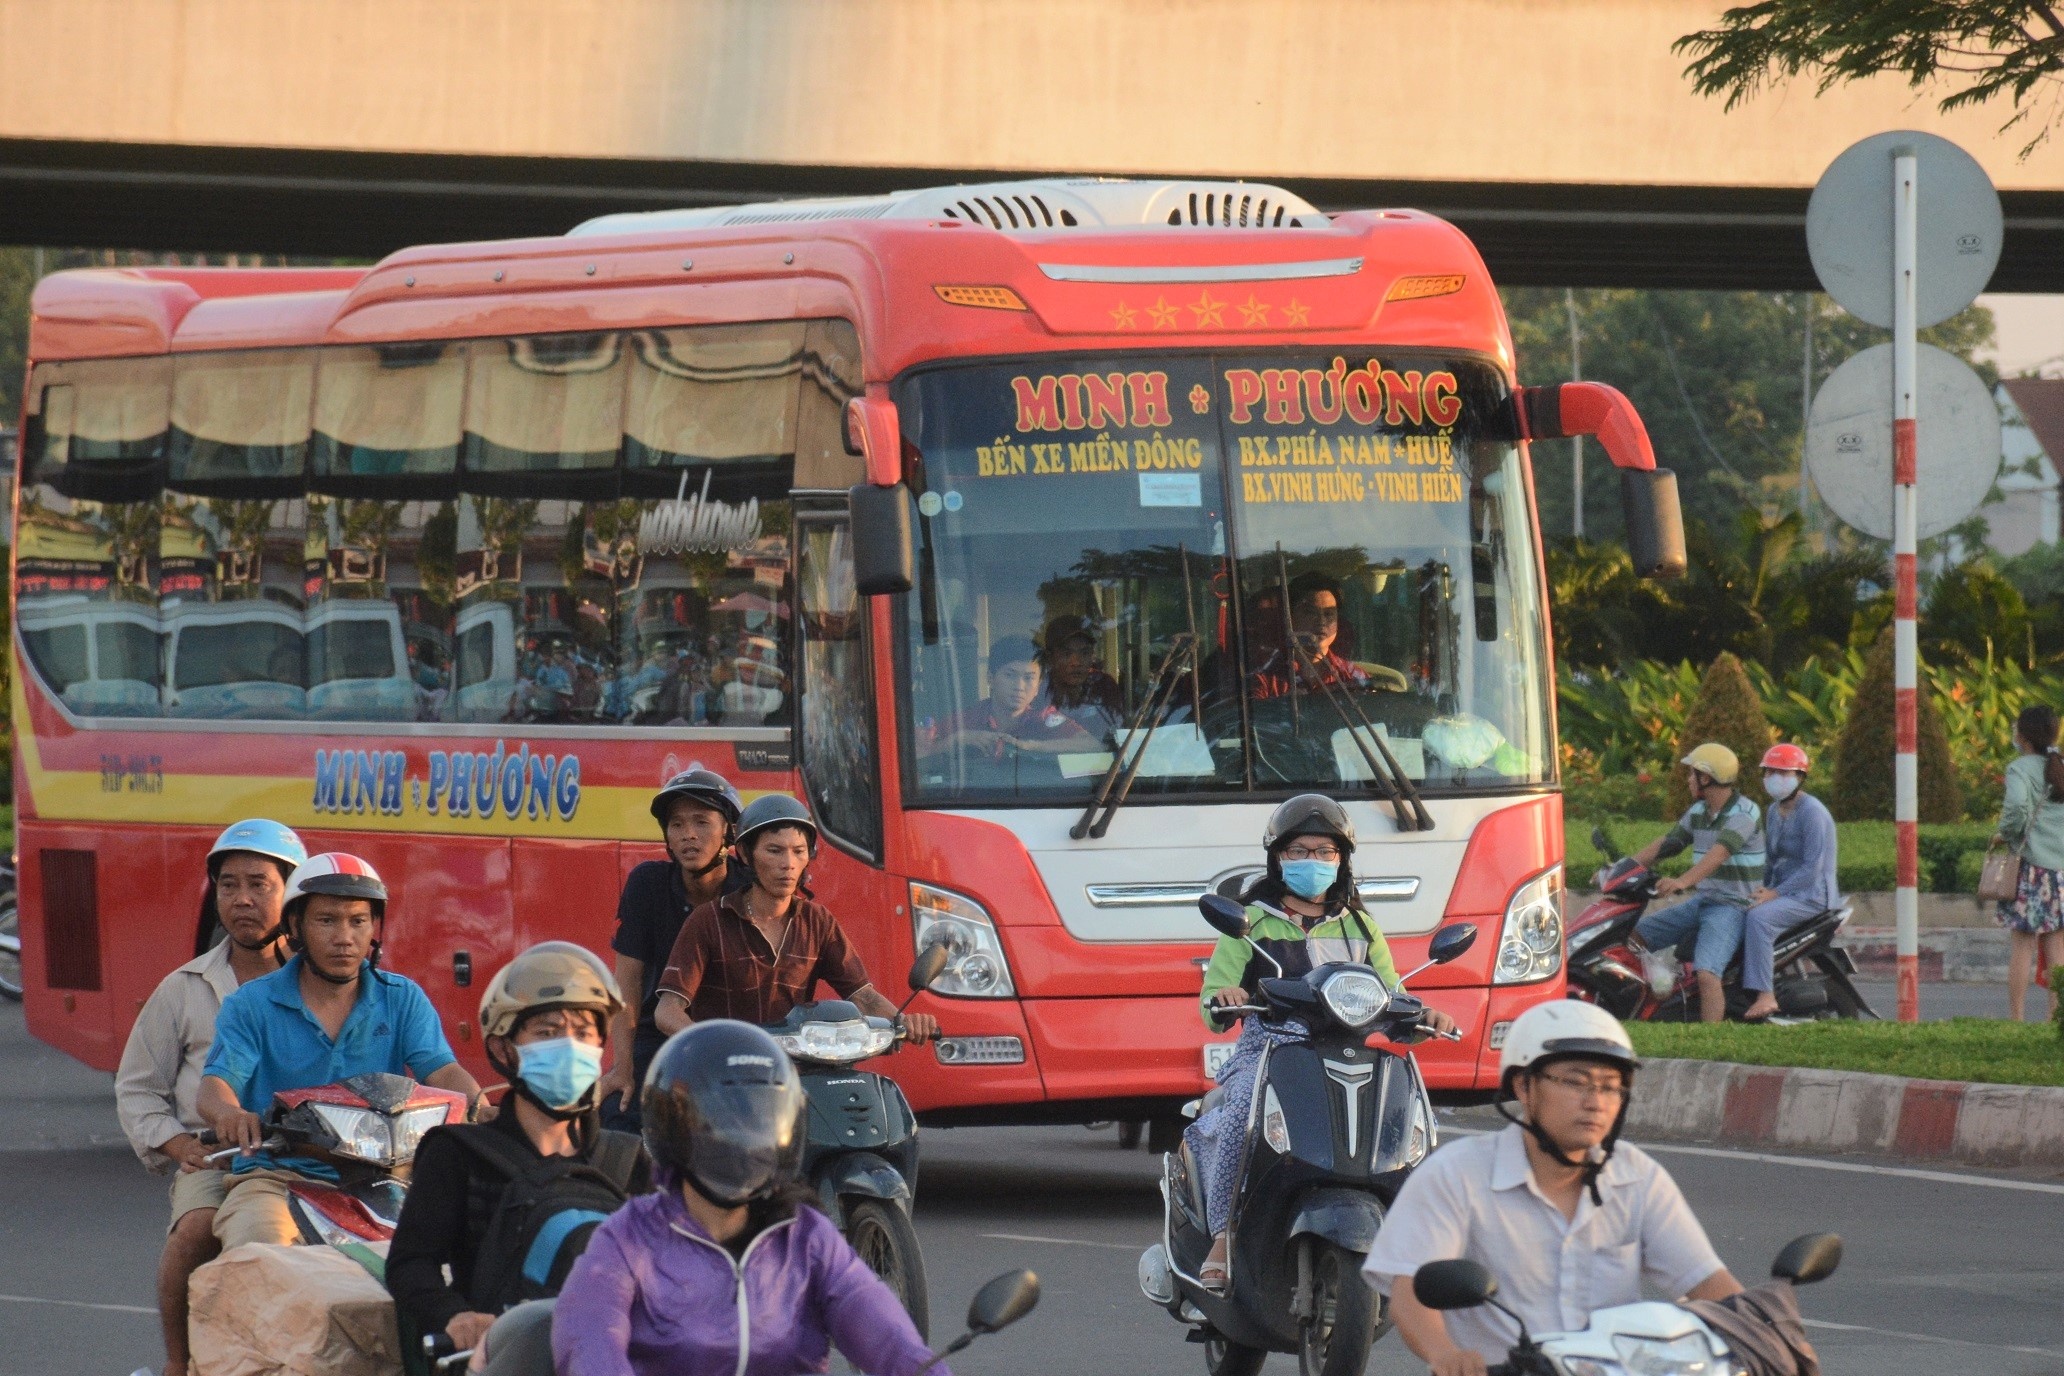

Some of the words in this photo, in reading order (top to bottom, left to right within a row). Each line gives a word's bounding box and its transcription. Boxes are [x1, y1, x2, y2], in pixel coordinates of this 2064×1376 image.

[1011, 371, 1172, 432] MINH
[1225, 356, 1462, 427] PHƯƠNG
[976, 434, 1027, 477] BẾN
[1031, 442, 1065, 474] XE
[1067, 431, 1129, 472] MIỀN
[1134, 431, 1202, 470] ĐÔNG
[1238, 428, 1335, 466] BX.PHÍA
[1338, 435, 1392, 465] NAM
[1405, 426, 1454, 466] HUẾ
[1243, 472, 1313, 503] BX.VINH
[1375, 472, 1419, 502] VINH
[1421, 465, 1463, 502] HIỀN
[312, 749, 406, 815] MINH
[426, 738, 581, 821] PHƯƠNG
[826, 1078, 867, 1086] HONDA
